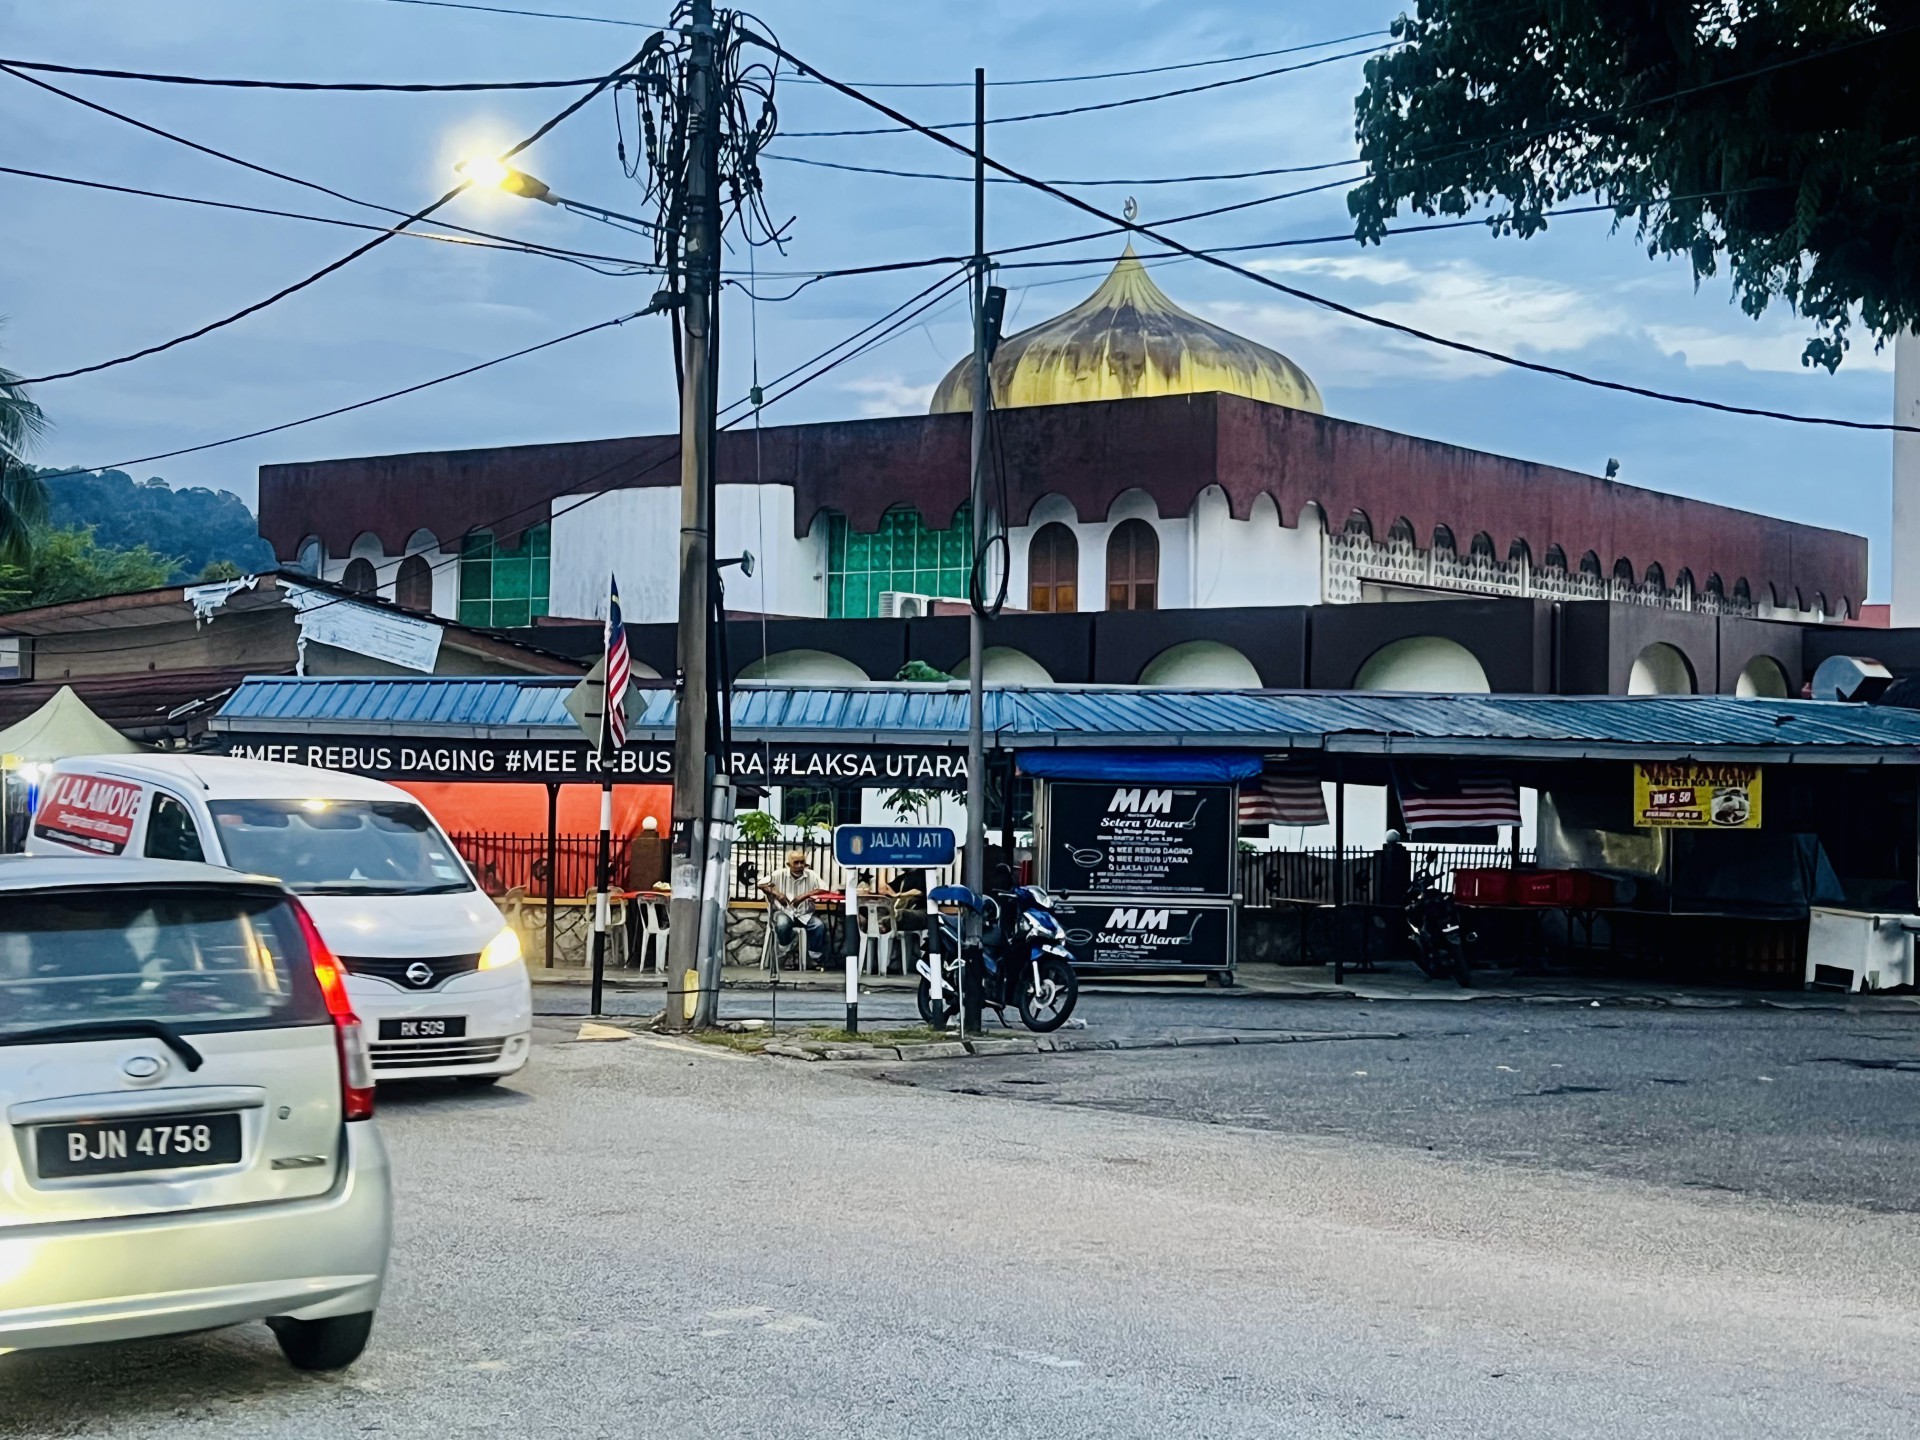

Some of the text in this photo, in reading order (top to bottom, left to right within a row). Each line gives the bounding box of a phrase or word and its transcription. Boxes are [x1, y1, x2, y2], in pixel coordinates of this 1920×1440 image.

[307, 747, 392, 770] REBUS
[401, 749, 495, 771] DAGING
[505, 750, 577, 772] #MEE
[773, 752, 877, 776] #LAKSA
[886, 754, 969, 778] UTARA
[1107, 788, 1173, 814] MM
[1100, 817, 1184, 829] Selera Utara
[869, 831, 941, 848] JALAN JATI
[1134, 846, 1162, 854] REBUS
[1162, 847, 1193, 855] DAGING
[1105, 908, 1170, 930] MM
[1095, 932, 1181, 945] Selera Utara
[68, 1125, 211, 1161] BJN 4758
